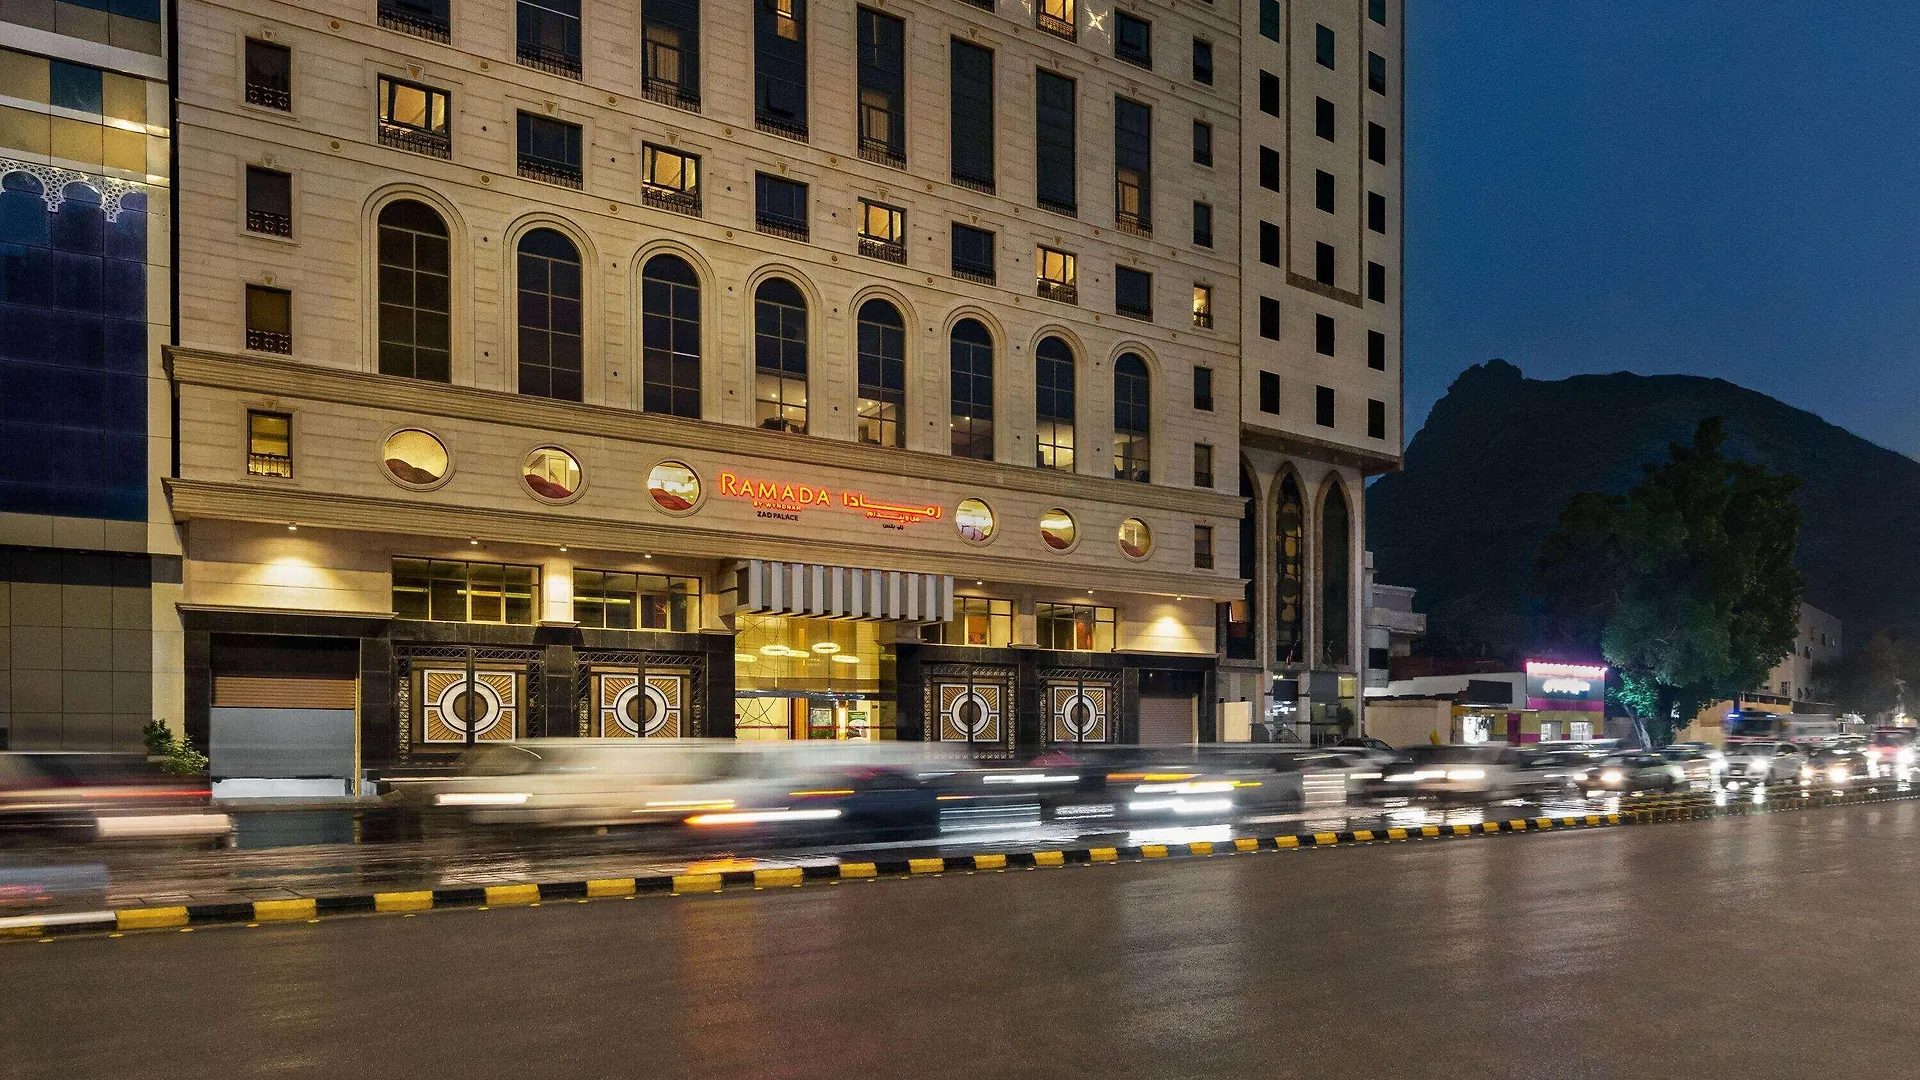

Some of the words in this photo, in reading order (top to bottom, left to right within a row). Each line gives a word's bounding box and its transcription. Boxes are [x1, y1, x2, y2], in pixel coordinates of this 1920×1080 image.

[720, 472, 831, 506] RAMADA
[753, 500, 763, 509] BY
[773, 512, 799, 521] PALACE
